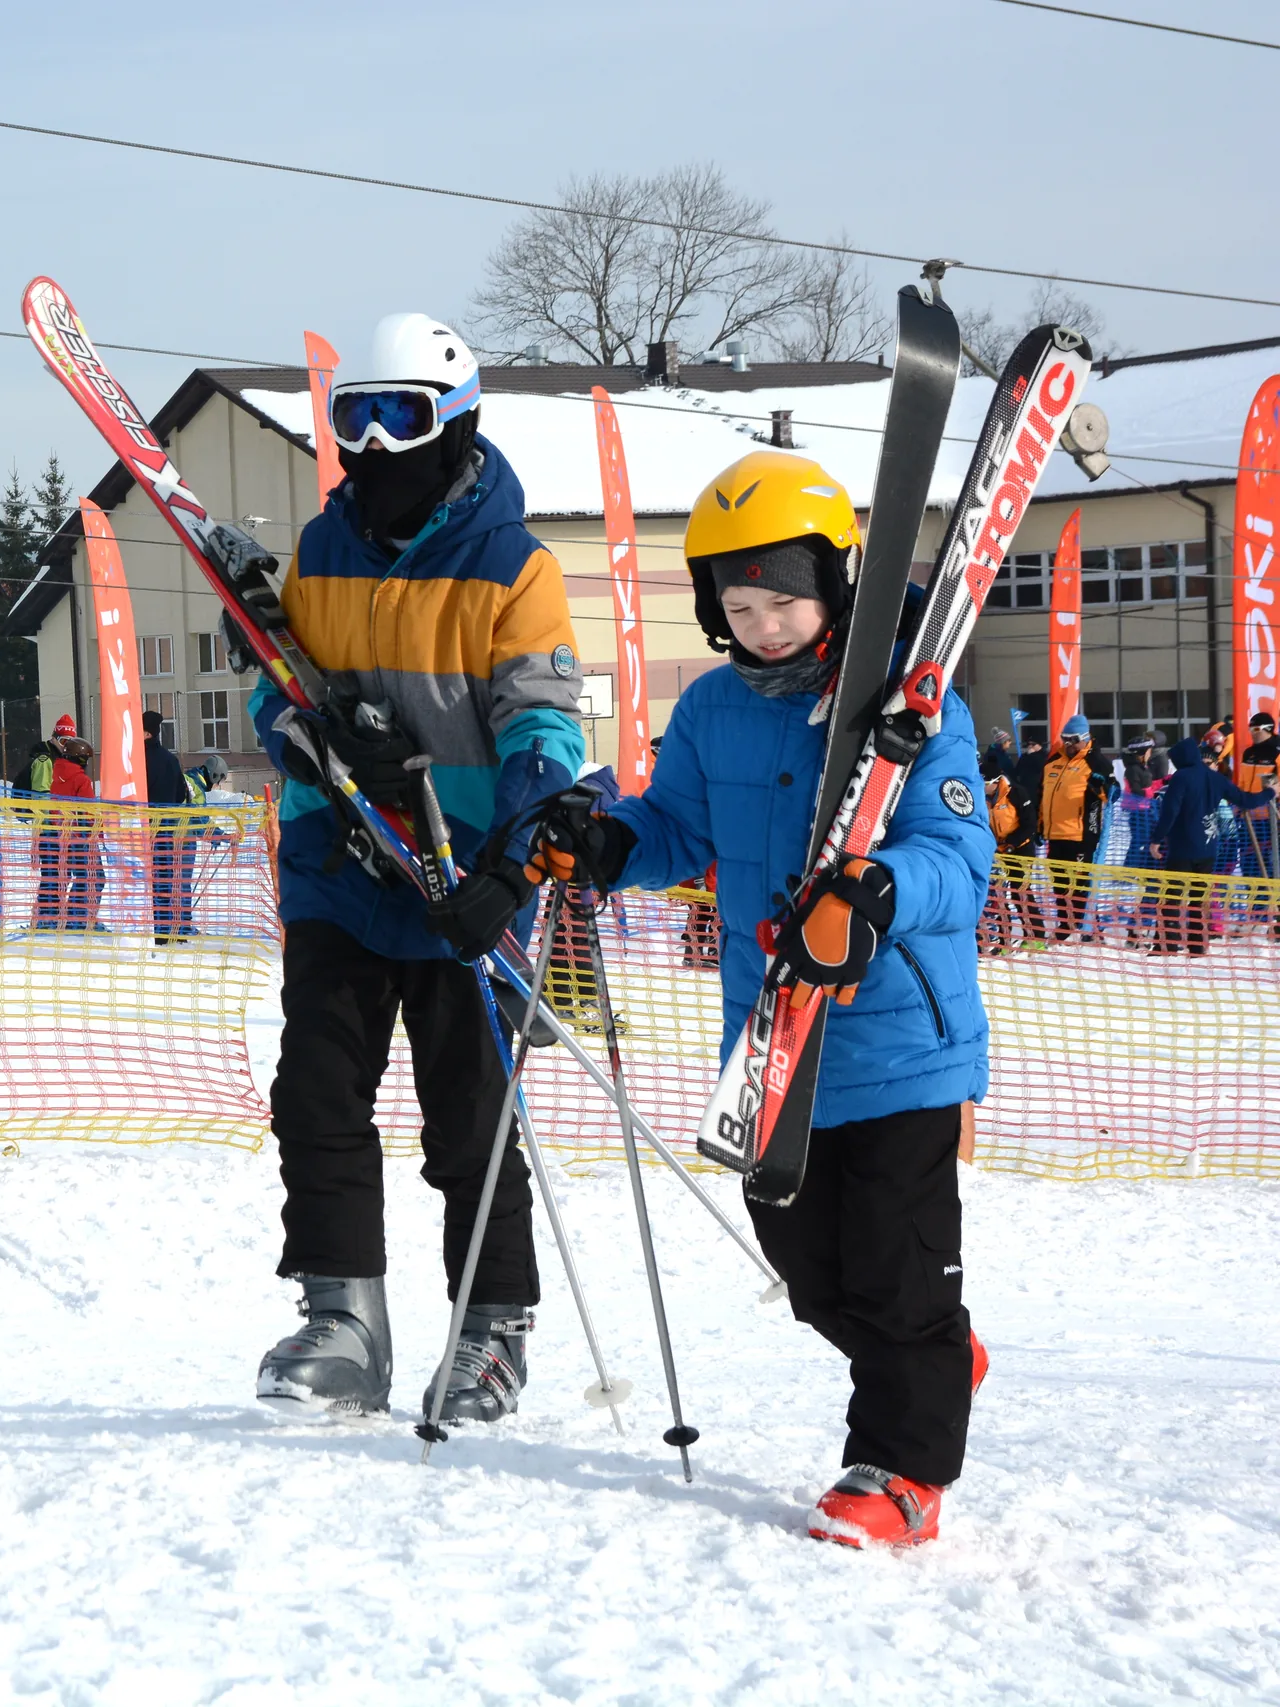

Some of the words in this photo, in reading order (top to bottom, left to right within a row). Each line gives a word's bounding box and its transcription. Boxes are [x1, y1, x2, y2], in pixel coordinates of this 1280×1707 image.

[49, 302, 163, 453] FISCHER
[965, 362, 1075, 620] ATOMIC
[422, 852, 443, 902] SCOTT
[768, 1049, 790, 1097] 120
